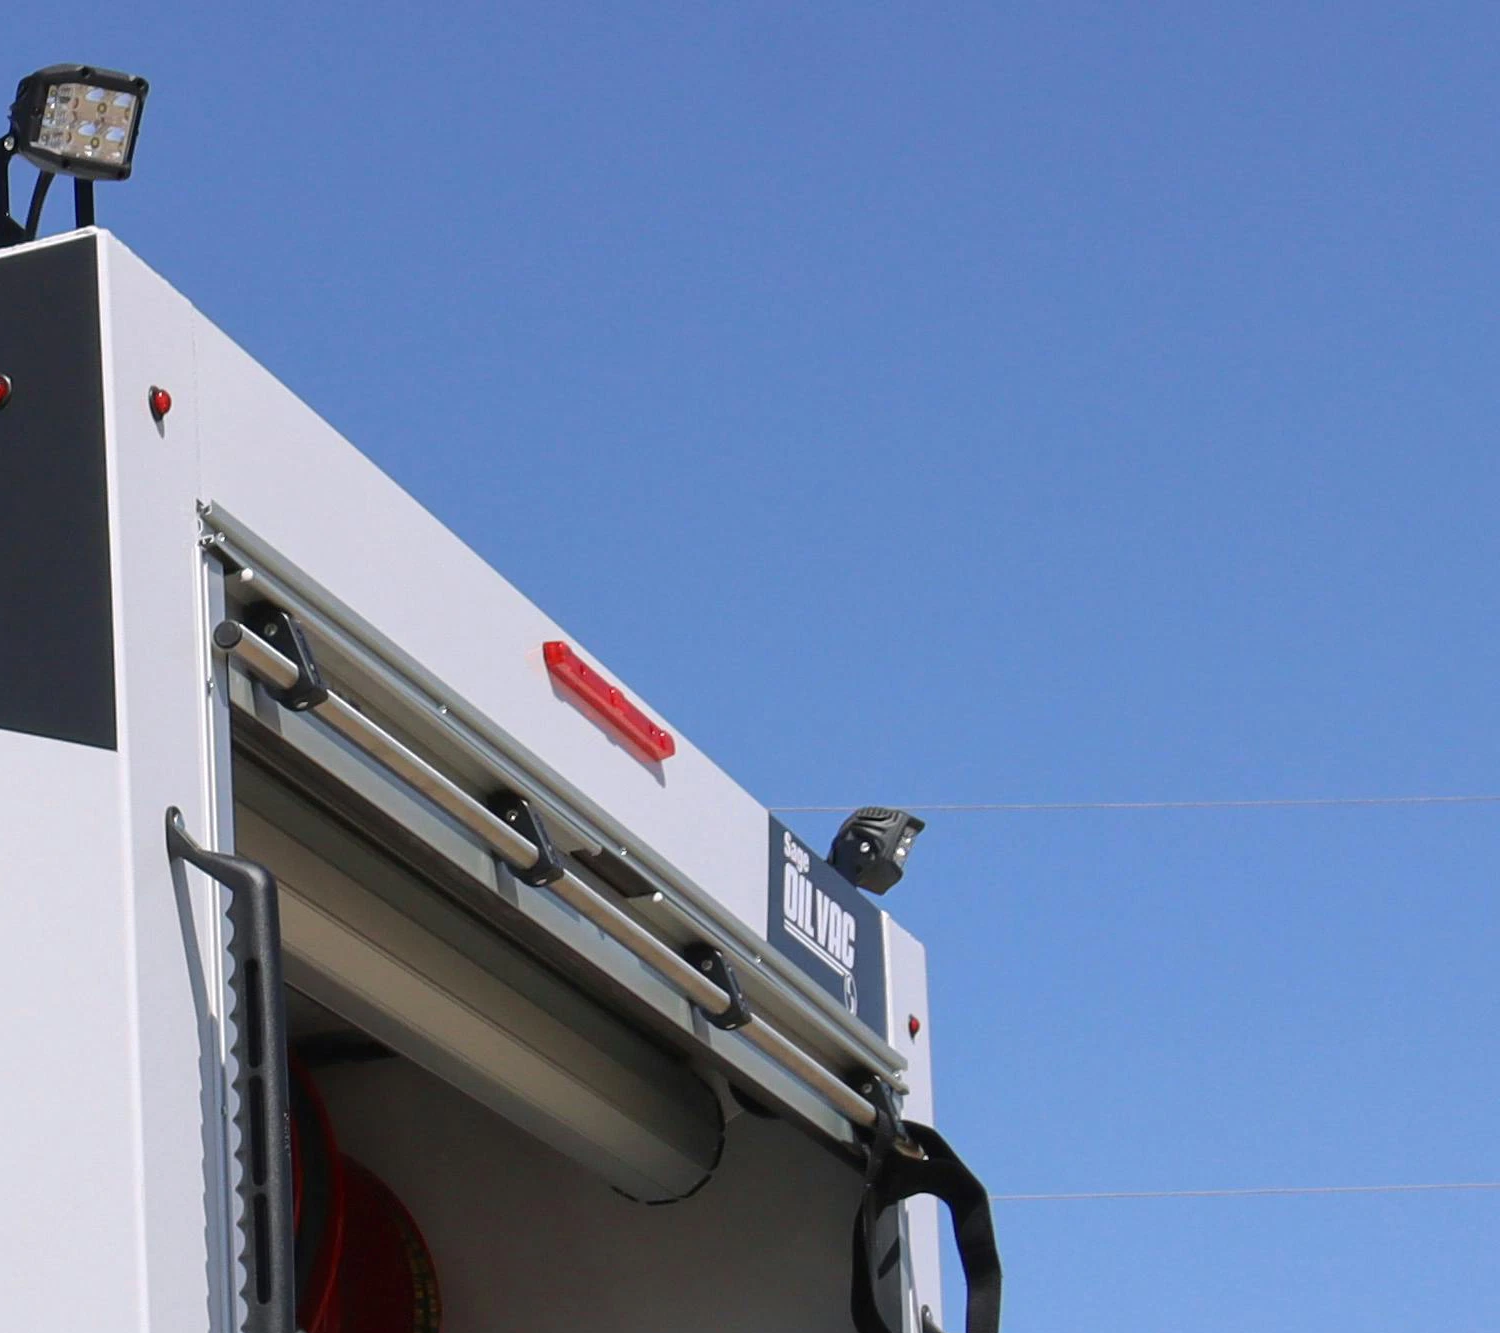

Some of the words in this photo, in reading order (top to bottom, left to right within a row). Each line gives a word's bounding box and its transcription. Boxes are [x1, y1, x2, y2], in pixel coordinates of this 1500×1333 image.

[783, 831, 810, 874] Sage
[783, 862, 816, 938] OIL
[816, 888, 856, 969] VAC
